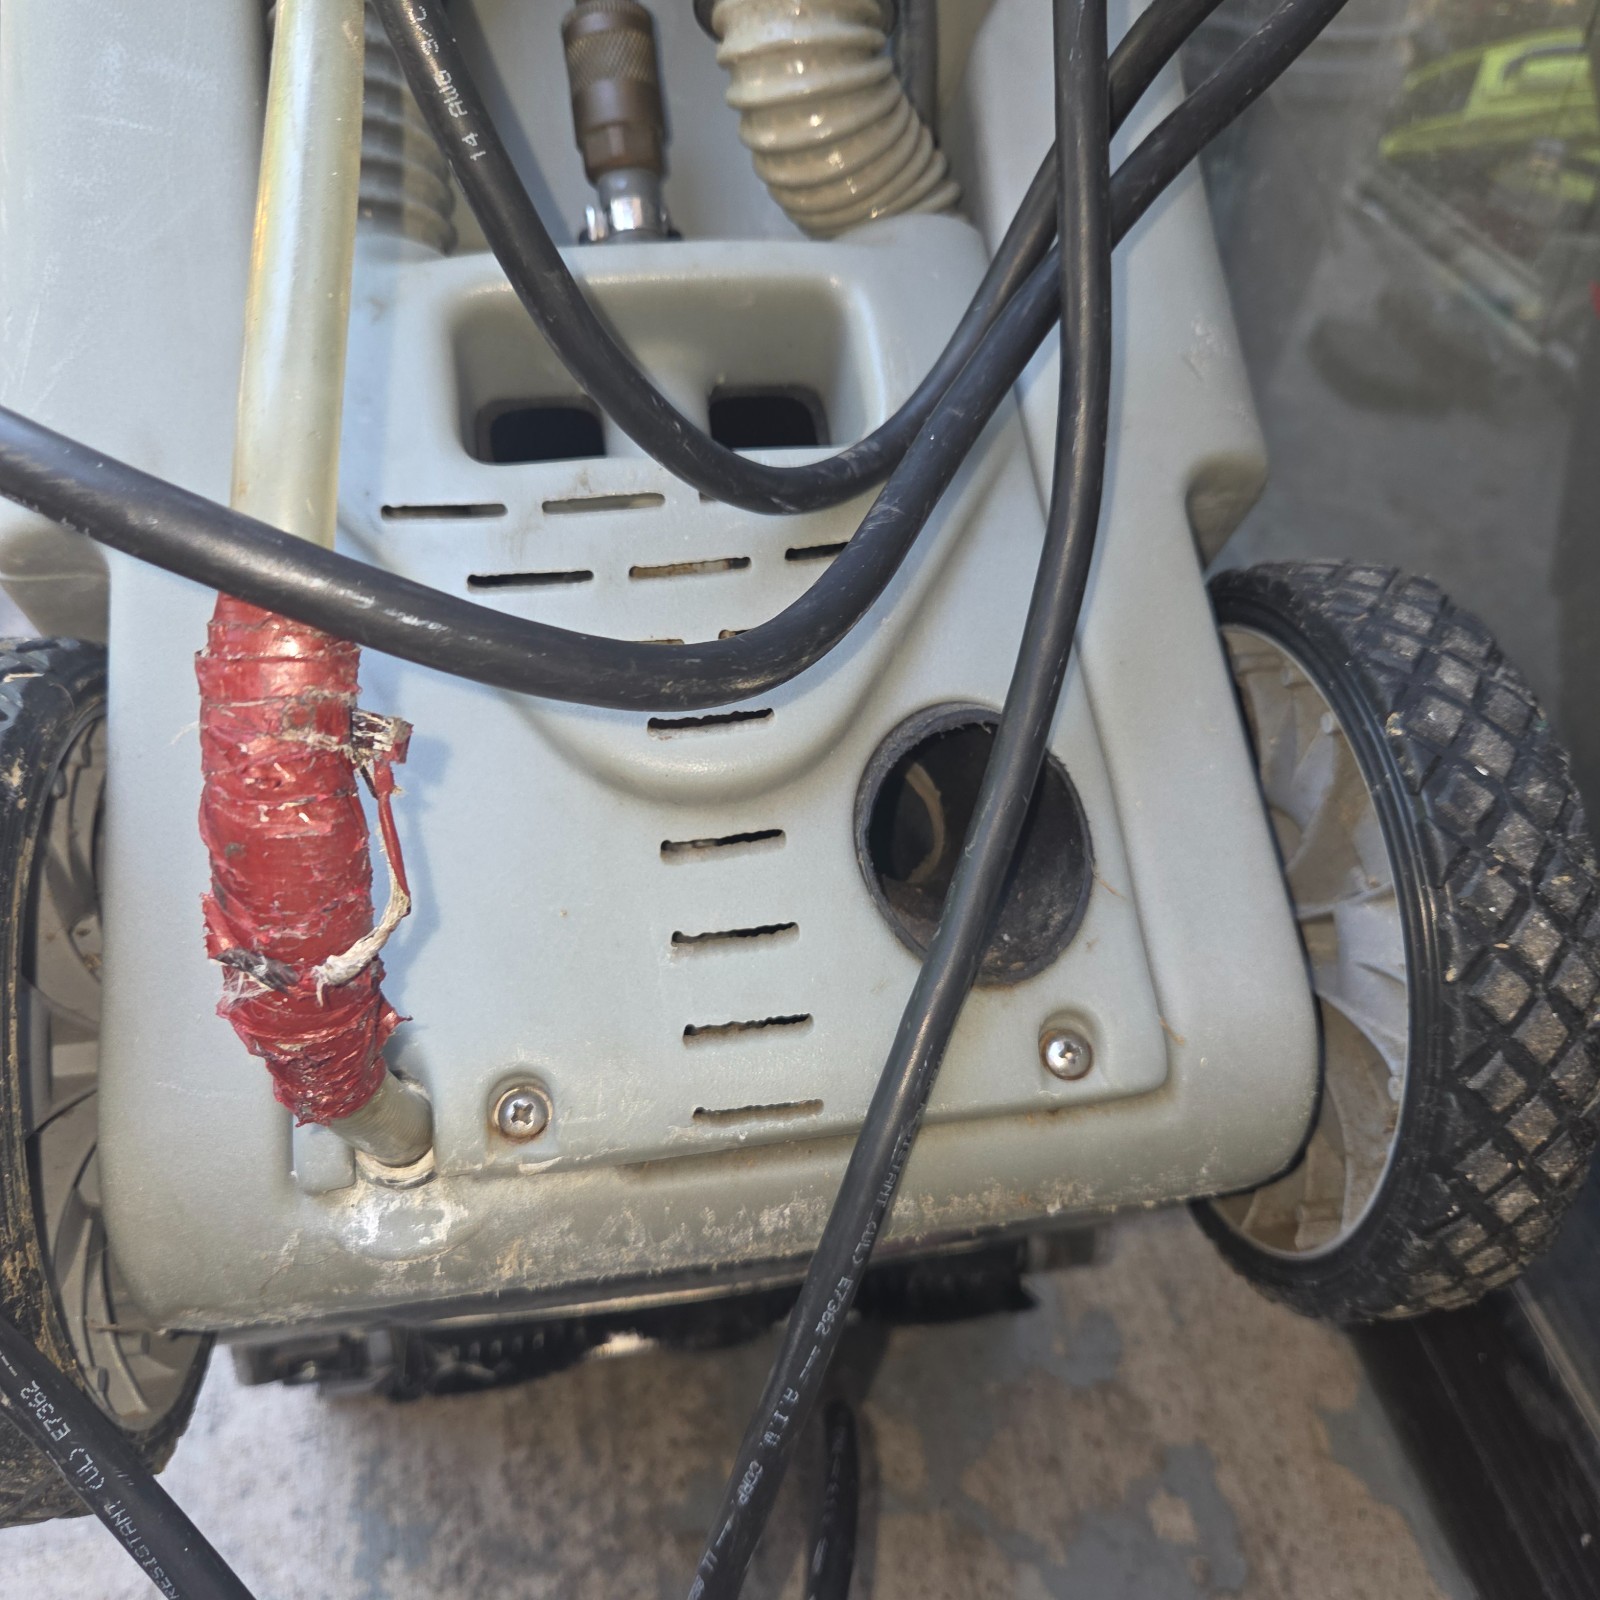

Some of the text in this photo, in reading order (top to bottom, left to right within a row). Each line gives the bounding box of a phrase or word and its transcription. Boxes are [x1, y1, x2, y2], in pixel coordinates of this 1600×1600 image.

[434, 69, 468, 118] AWG
[462, 132, 486, 161] 14
[815, 1276, 853, 1336] E7362
[20, 1380, 71, 1442] E7362
[69, 1448, 105, 1490] (UL)
